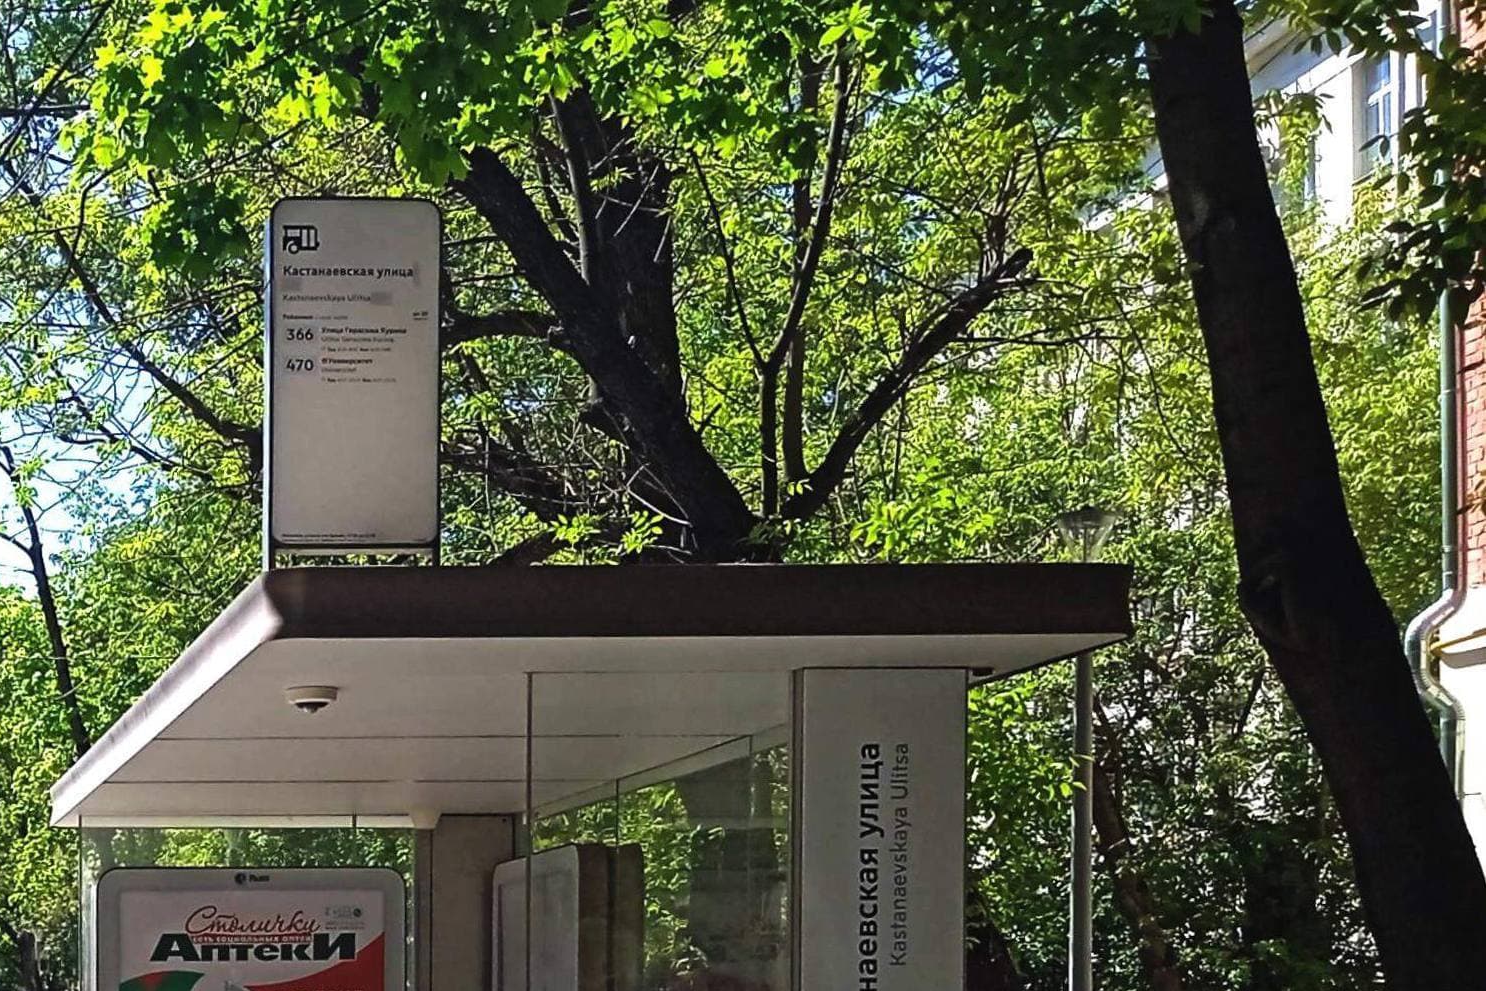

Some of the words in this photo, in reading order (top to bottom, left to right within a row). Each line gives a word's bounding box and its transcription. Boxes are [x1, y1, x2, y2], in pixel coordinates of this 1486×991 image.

[283, 266, 374, 277] Кастанаевская
[377, 267, 414, 279] улица
[286, 328, 314, 341] 366
[286, 359, 314, 372] 470
[890, 743, 910, 799] Ulitsa
[859, 742, 885, 838] улица
[889, 806, 912, 966] Kastanaevskaya
[184, 905, 321, 934] Столички
